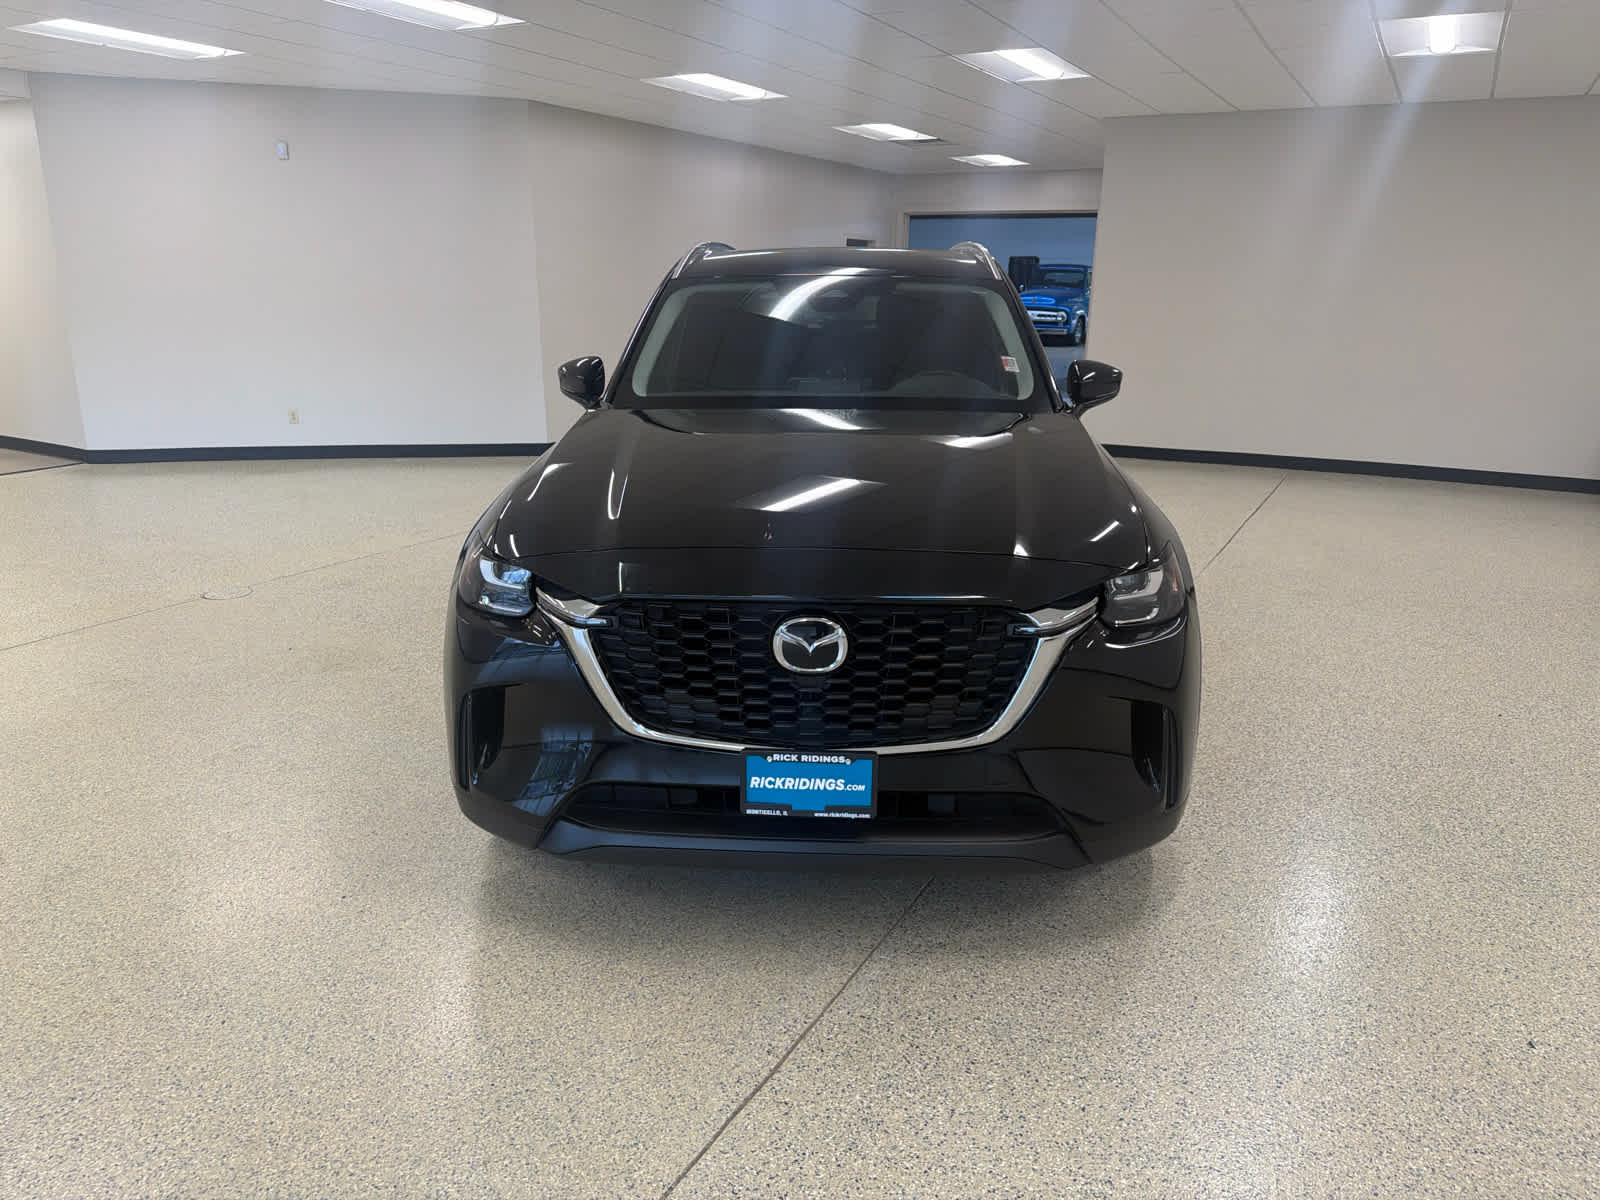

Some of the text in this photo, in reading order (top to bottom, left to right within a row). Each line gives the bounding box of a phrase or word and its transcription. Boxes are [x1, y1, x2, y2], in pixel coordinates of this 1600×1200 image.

[772, 753, 846, 764] RICK RIDINGS
[750, 776, 865, 791] RICKRIDINGS.COM
